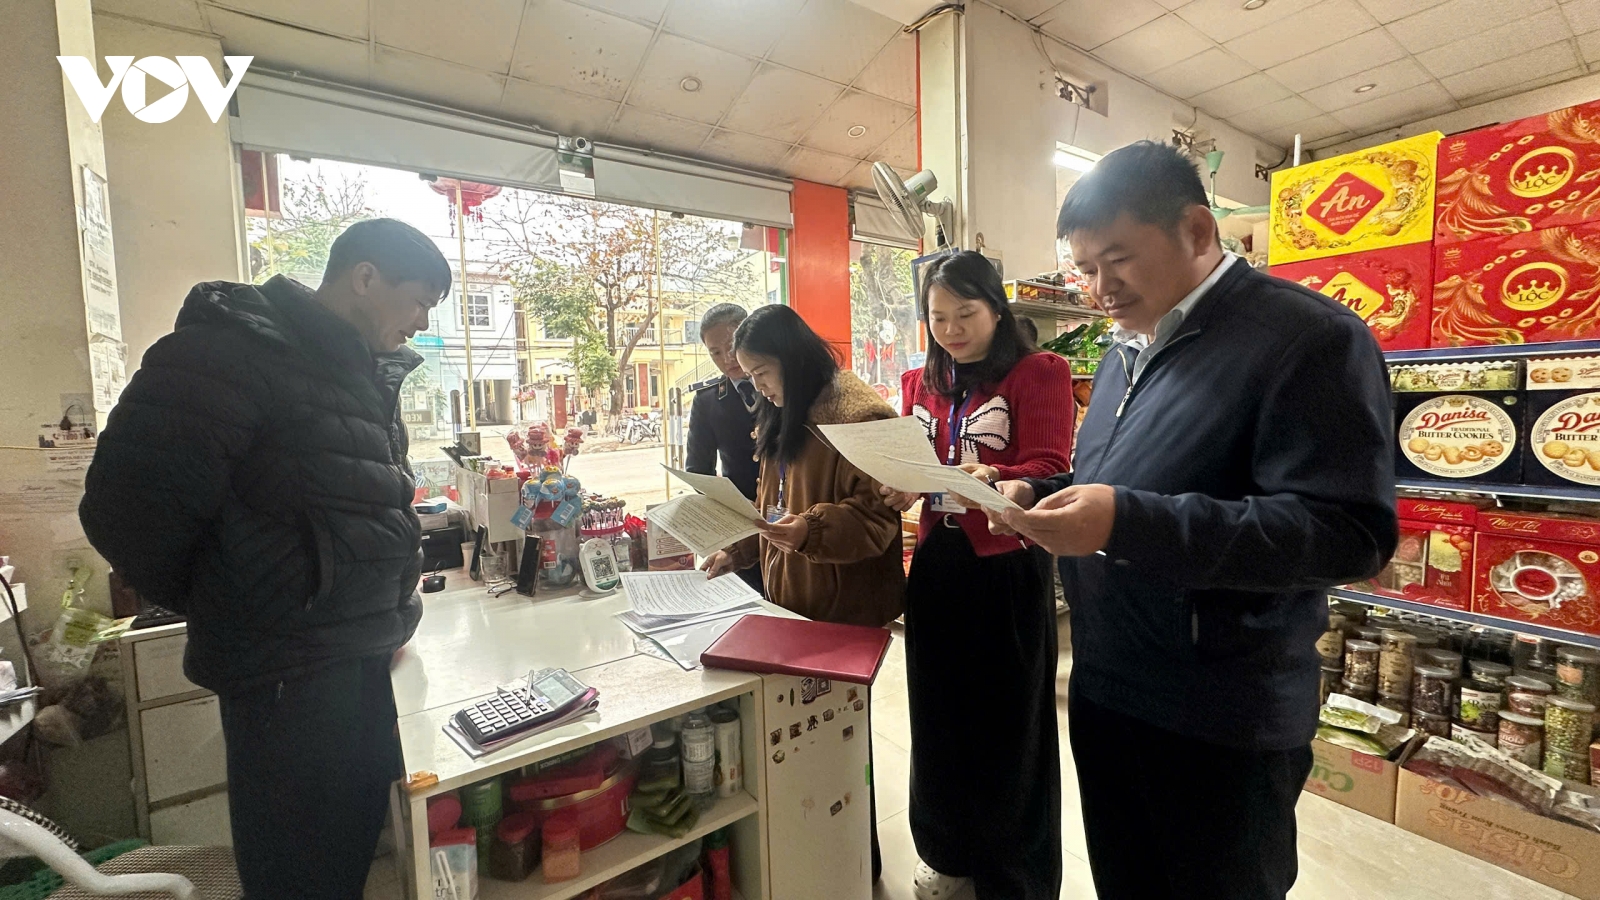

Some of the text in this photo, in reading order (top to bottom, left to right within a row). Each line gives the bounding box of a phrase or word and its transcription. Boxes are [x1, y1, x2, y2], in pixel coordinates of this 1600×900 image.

[1525, 174, 1556, 189] LỘC
[1320, 186, 1371, 218] An
[1519, 289, 1549, 303] LỘC
[1415, 406, 1491, 431] Danisa
[1555, 433, 1598, 441] BUTTER
